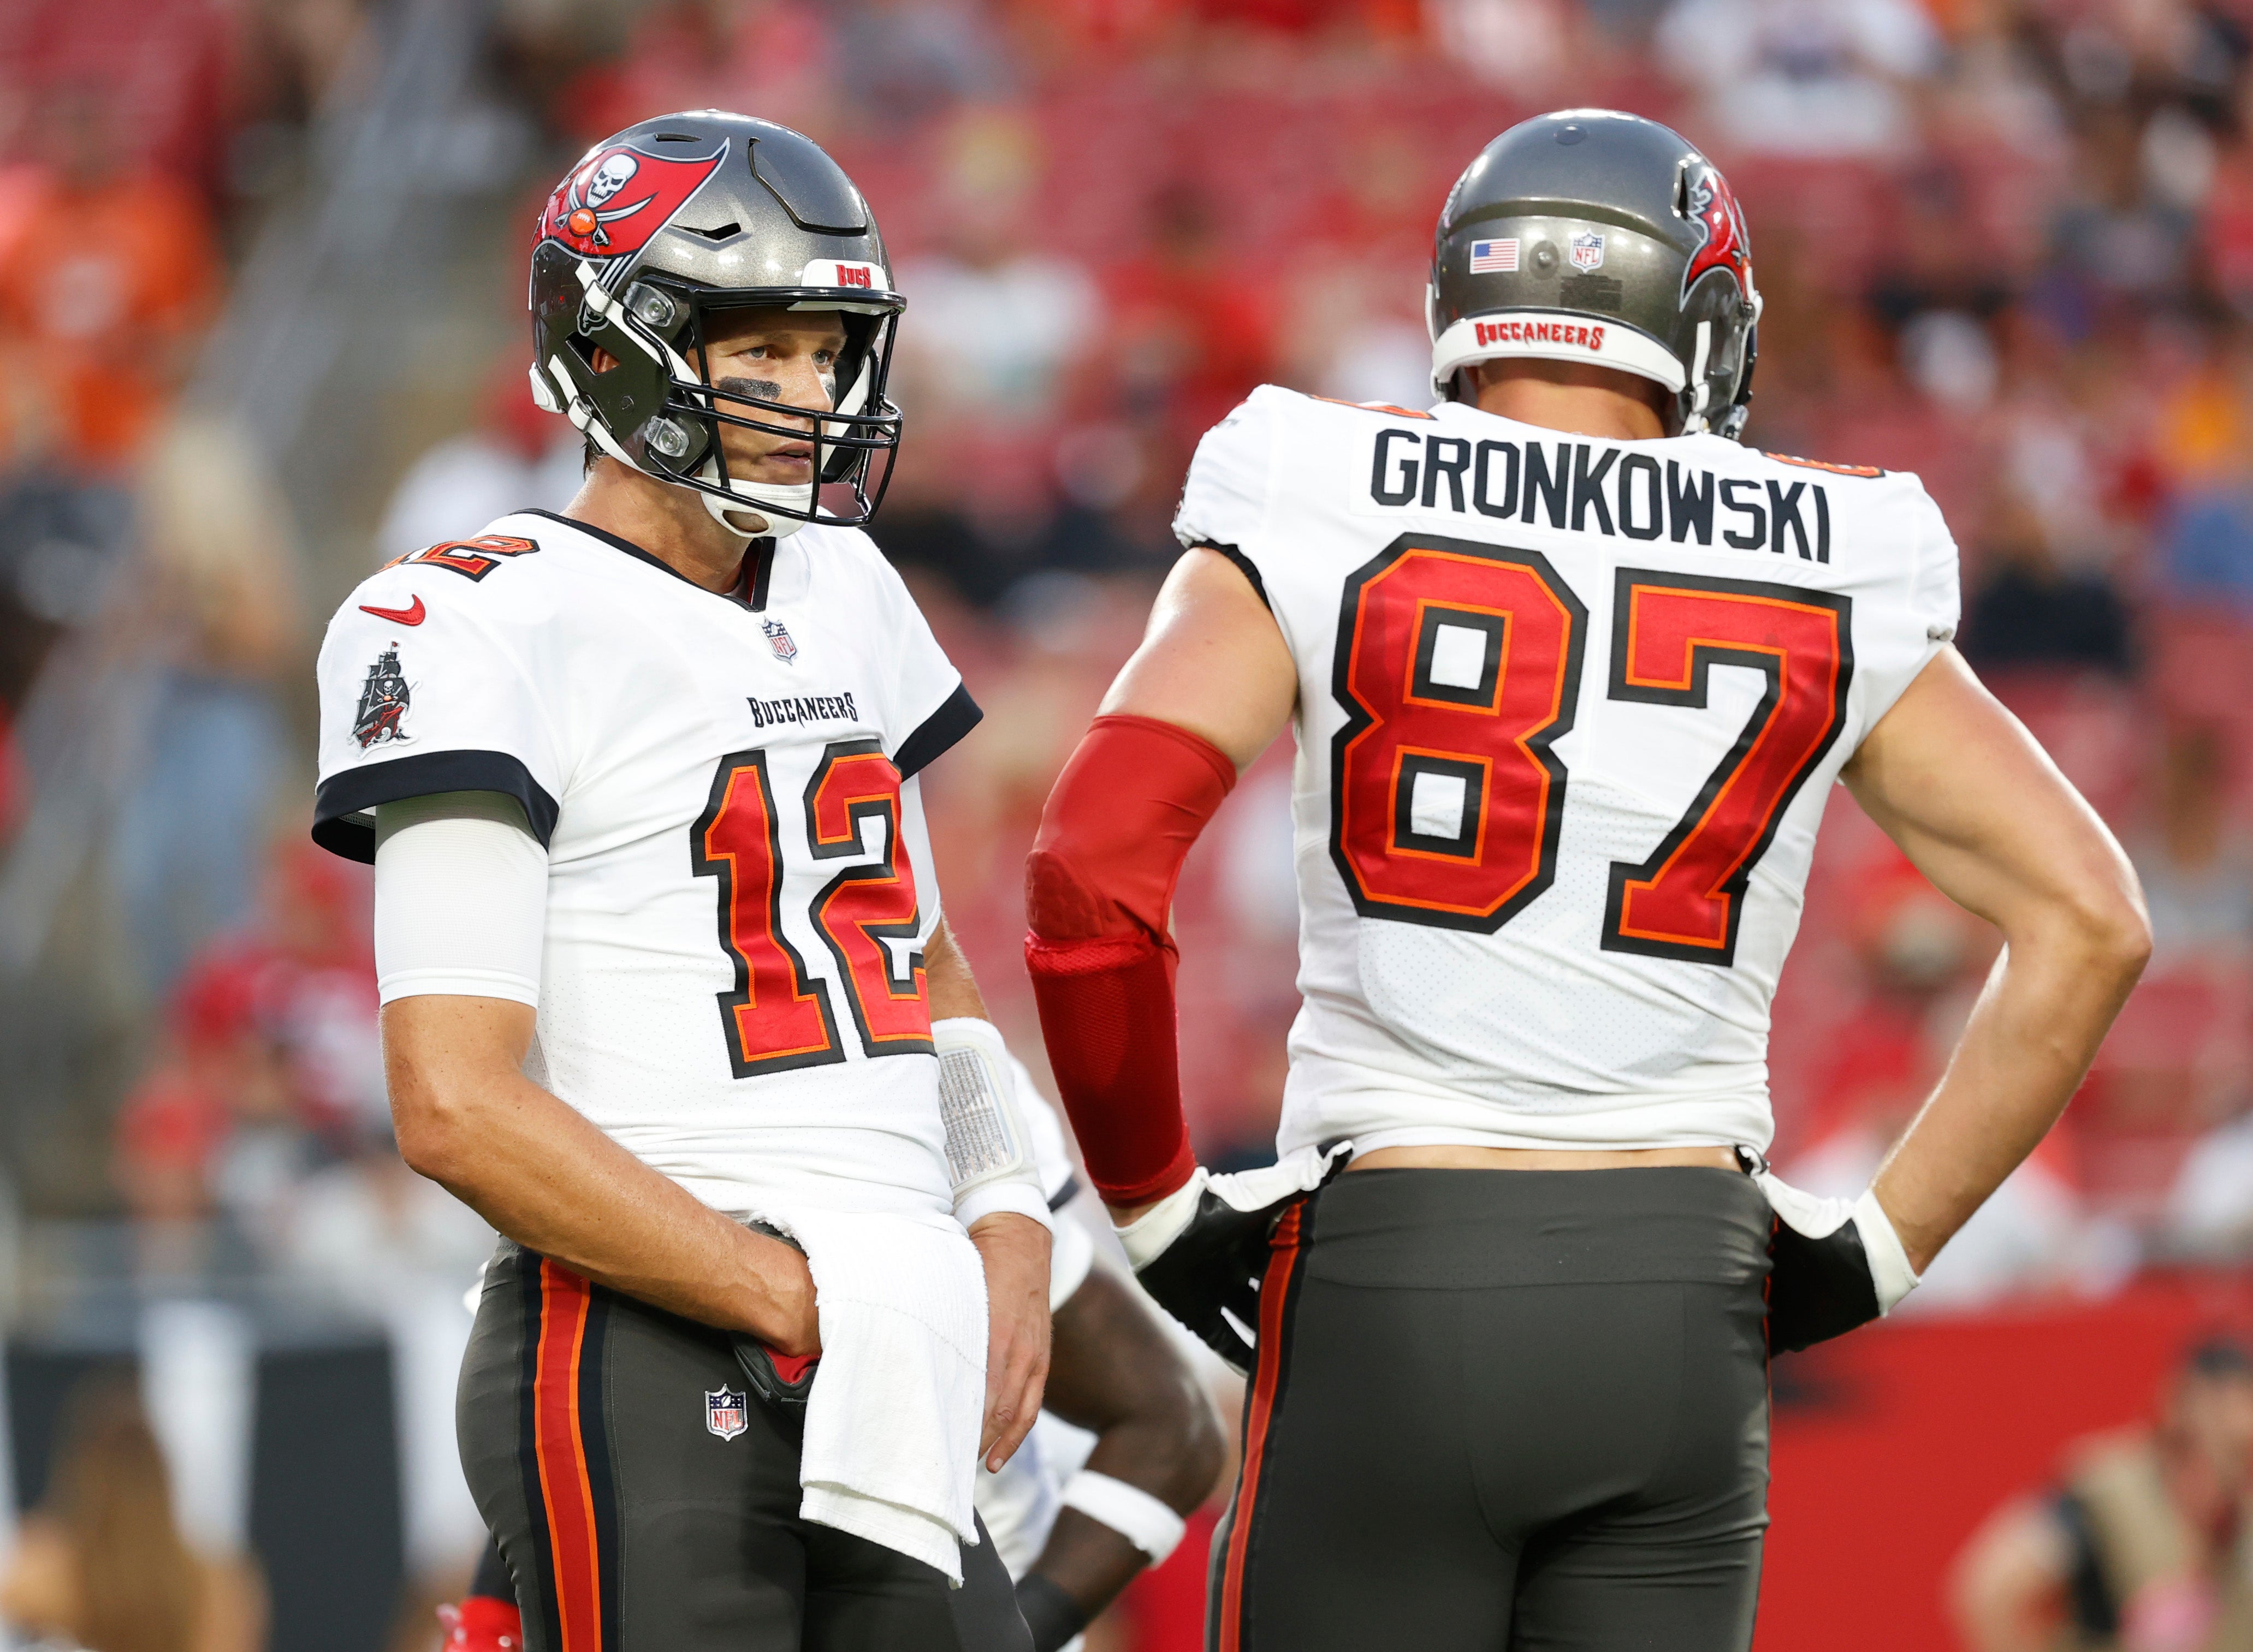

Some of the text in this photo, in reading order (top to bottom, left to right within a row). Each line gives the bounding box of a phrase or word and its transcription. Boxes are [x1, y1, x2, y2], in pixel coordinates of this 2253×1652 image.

[1575, 247, 1599, 265] NFL
[1474, 322, 1605, 351] BUCCANEERS
[1371, 429, 1830, 565] GRONKOWSKI
[377, 534, 541, 583] 2
[770, 636, 795, 655] NFL
[746, 691, 858, 729] BUCCANEERS
[1330, 531, 1854, 967] 87
[690, 739, 938, 1079] 12
[713, 1410, 744, 1431] NFL
